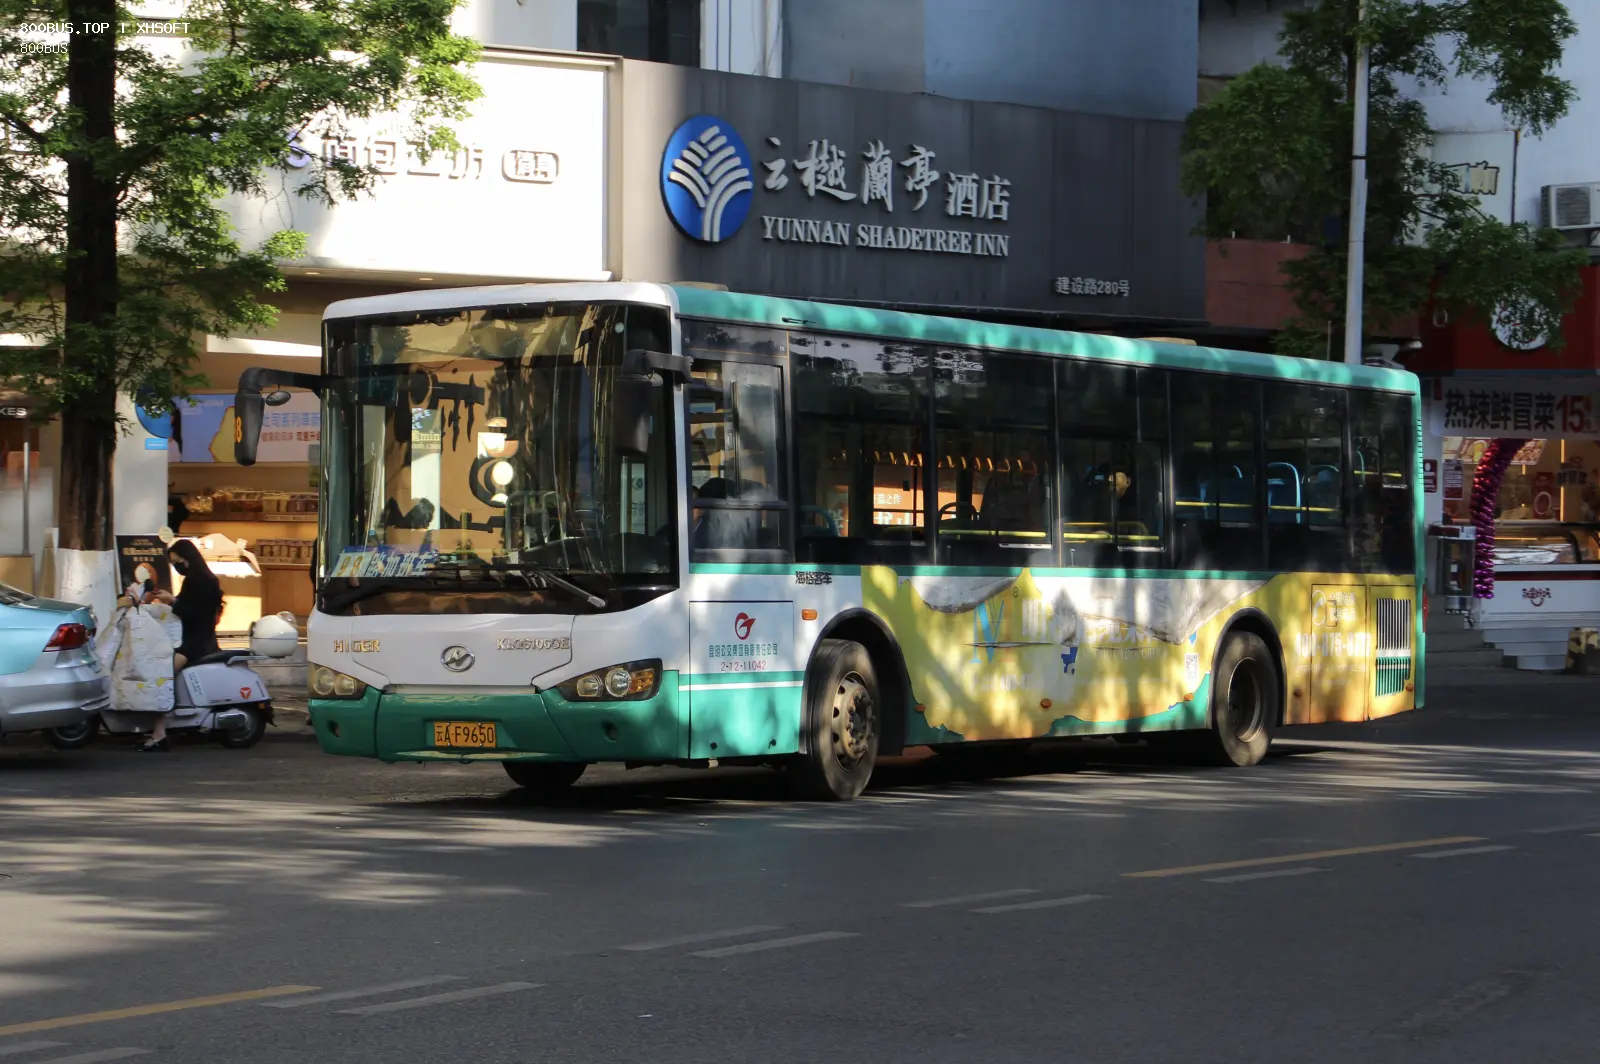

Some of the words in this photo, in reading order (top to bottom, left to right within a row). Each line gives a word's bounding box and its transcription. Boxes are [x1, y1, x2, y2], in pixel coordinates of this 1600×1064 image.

[761, 215, 851, 246] YUNNAN
[856, 223, 972, 254] SHADETREE
[973, 233, 1010, 257] INN
[1056, 276, 1131, 297] 建设路280号
[1443, 387, 1556, 433] 热辣鲜冒菜
[334, 639, 380, 652] HIGER
